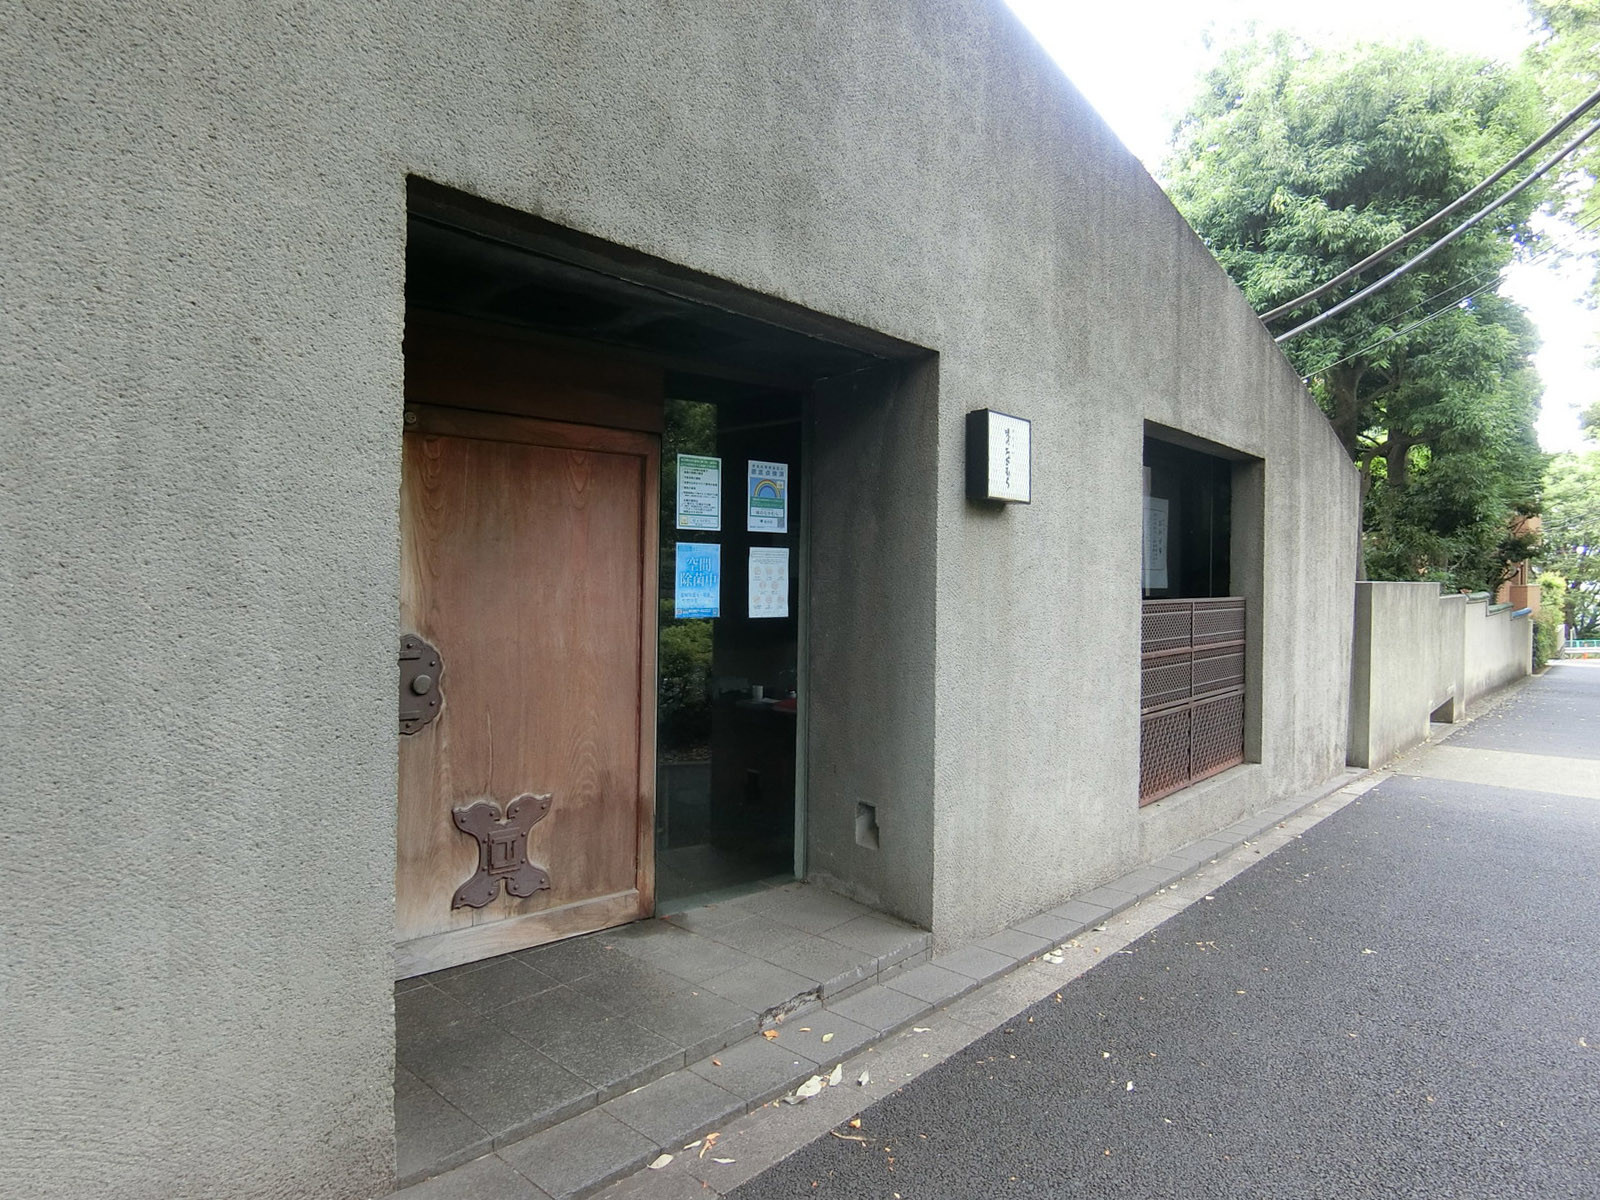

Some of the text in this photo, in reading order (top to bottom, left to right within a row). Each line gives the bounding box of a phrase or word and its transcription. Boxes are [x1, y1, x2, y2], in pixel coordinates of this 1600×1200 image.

[686, 557, 711, 573] 空間
[679, 572, 717, 587] 除菌中
